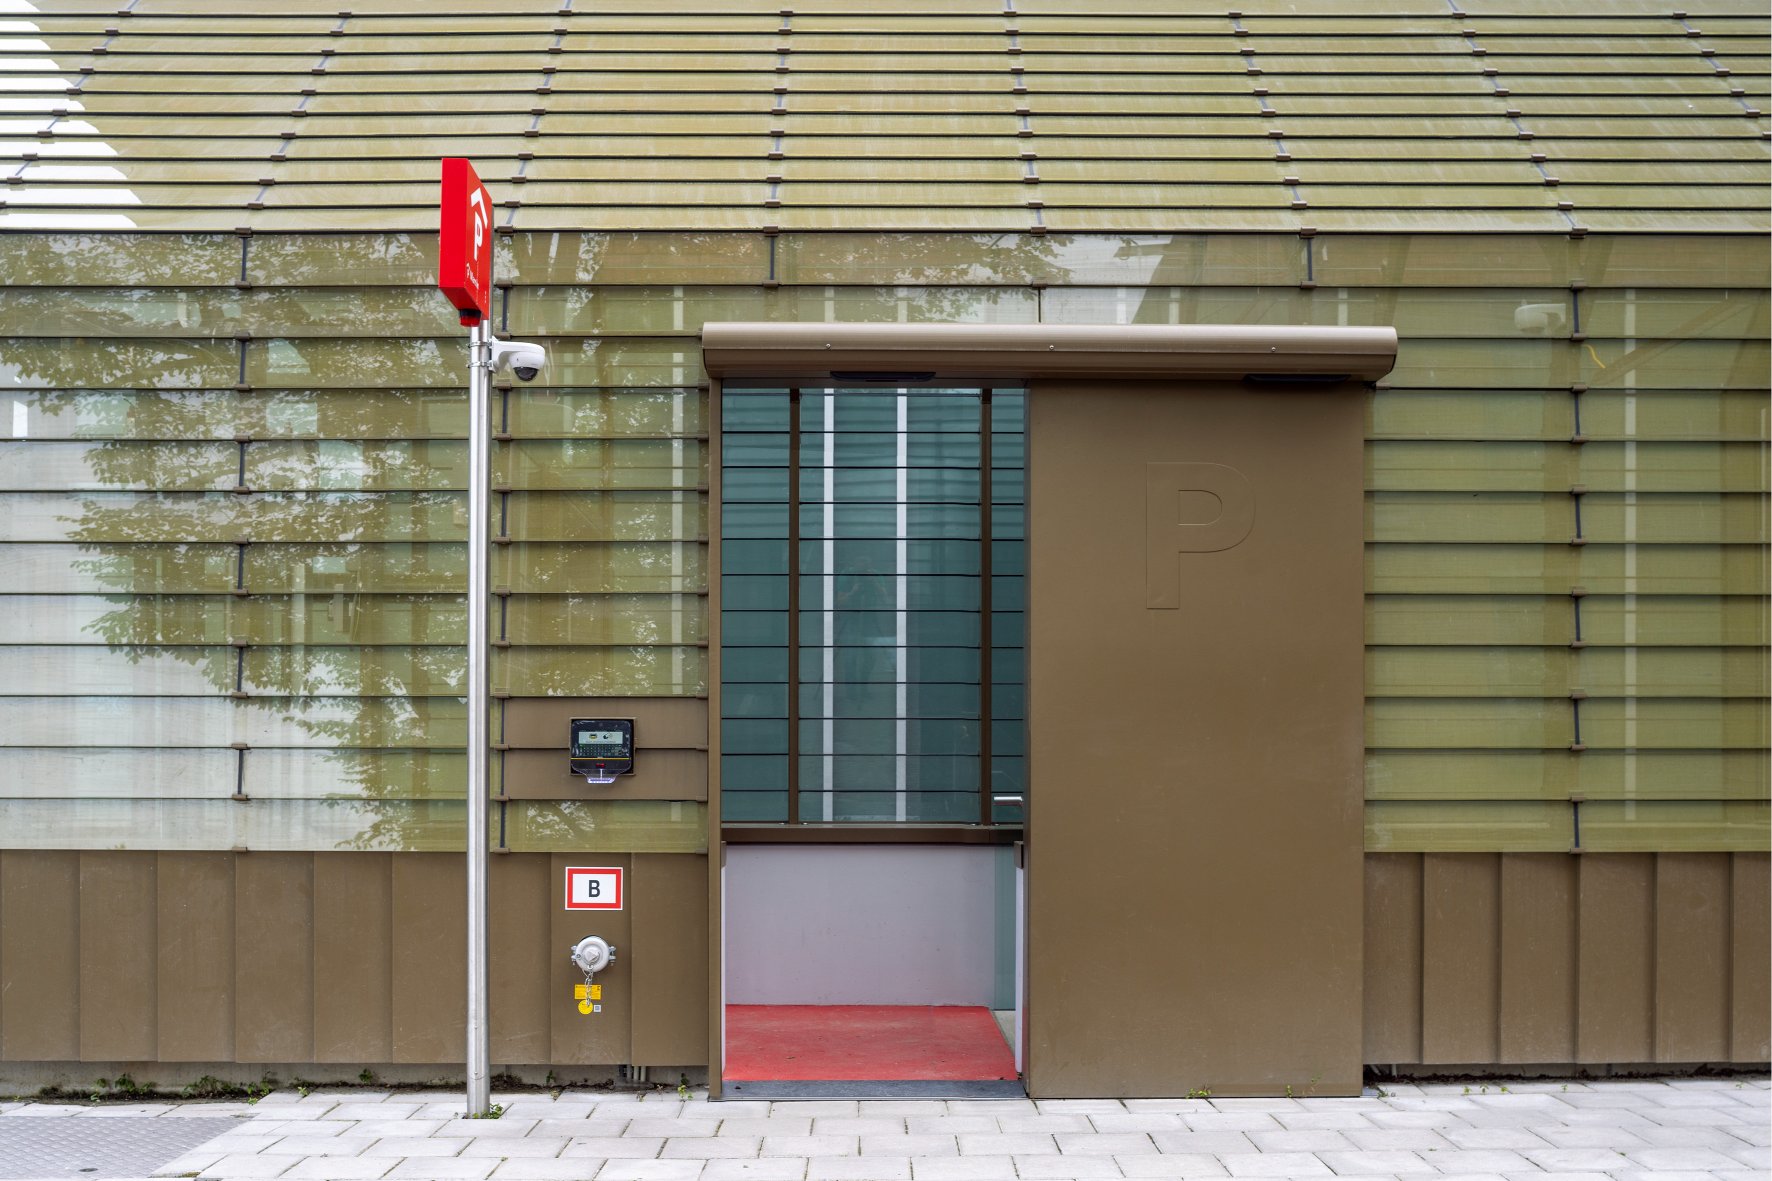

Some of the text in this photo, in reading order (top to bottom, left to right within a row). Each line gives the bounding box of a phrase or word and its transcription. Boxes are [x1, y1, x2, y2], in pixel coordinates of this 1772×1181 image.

[473, 211, 483, 261] P
[1146, 462, 1256, 610] P
[588, 879, 601, 898] B
